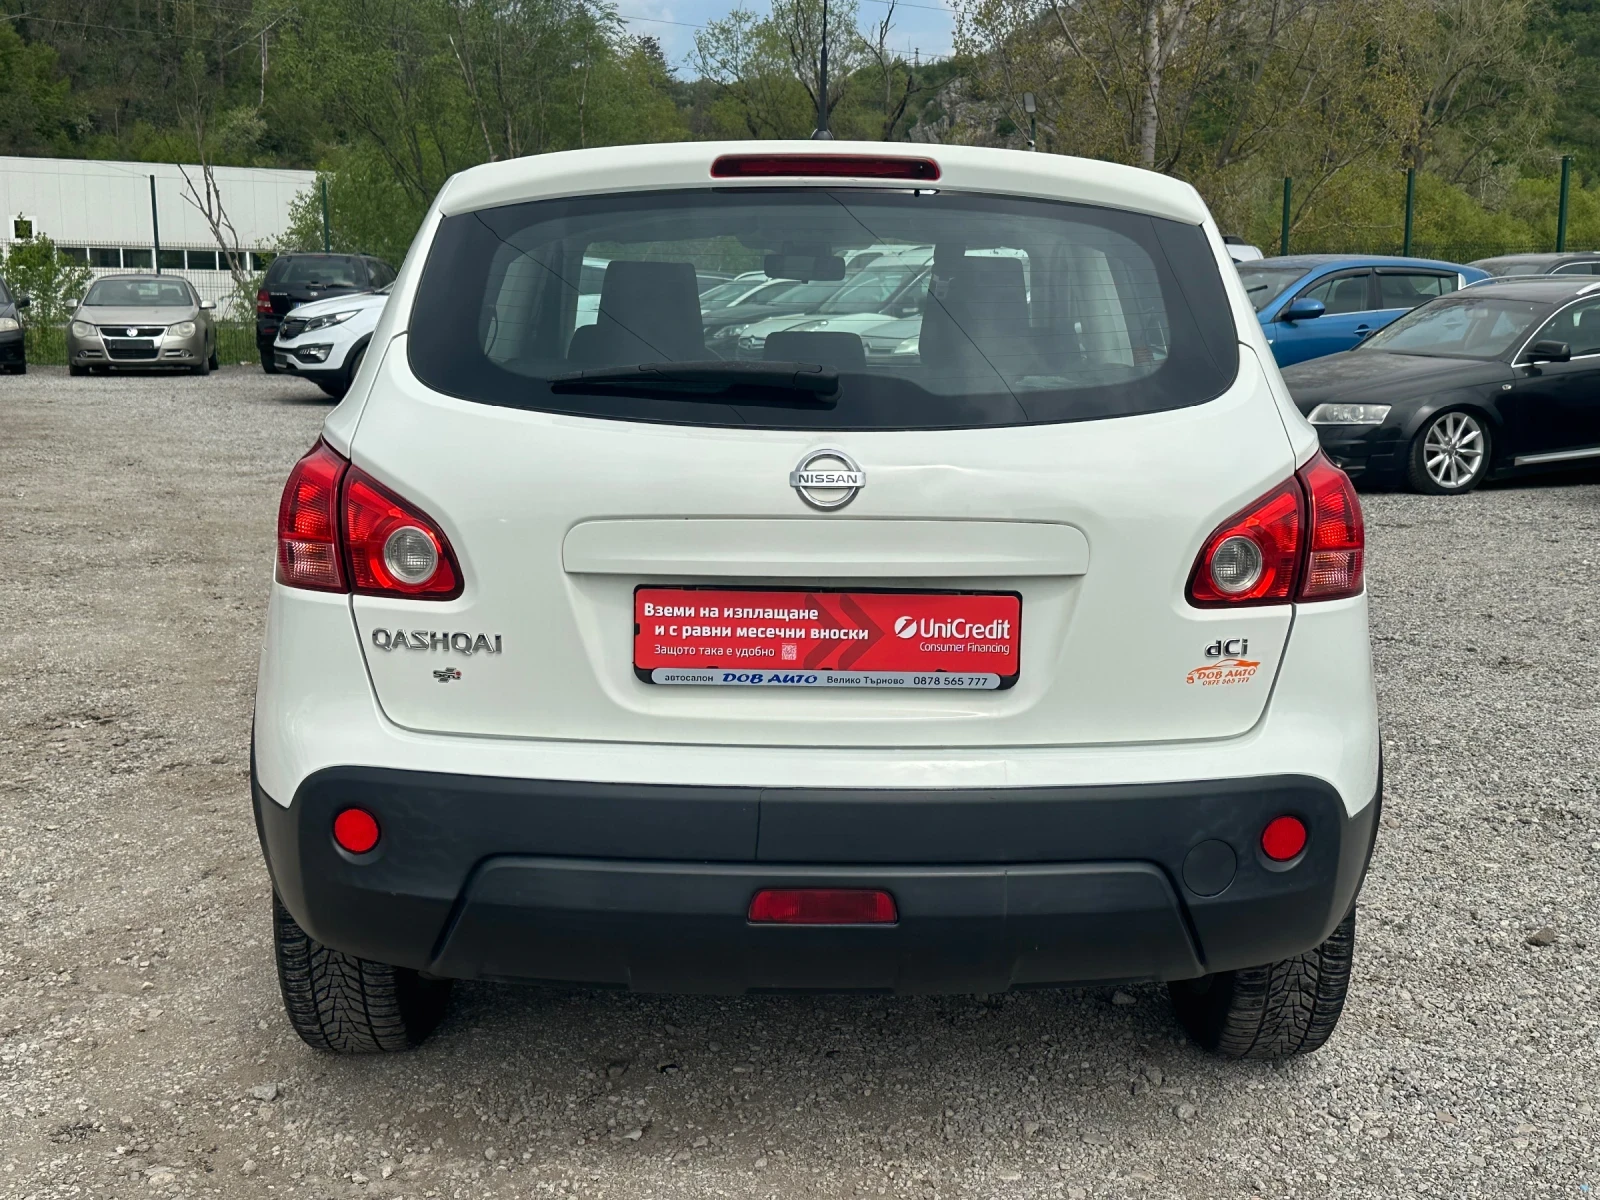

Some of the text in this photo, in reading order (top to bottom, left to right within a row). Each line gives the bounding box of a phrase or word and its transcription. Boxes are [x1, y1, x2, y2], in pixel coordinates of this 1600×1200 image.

[798, 474, 858, 484] NISSAN
[644, 602, 819, 622] Вземи на изплащане
[654, 624, 869, 640] и с равни месечни вноски
[919, 617, 1011, 640] UniCredit
[371, 627, 503, 656] QASHQAI
[919, 641, 1010, 656] Consumer Financing
[1204, 638, 1249, 657] dCi
[654, 644, 775, 658] Защото така е удобно
[664, 672, 988, 687] автосалон DOB AUTO Велико Търново 0878 565 777
[1224, 667, 1256, 678] AUTO
